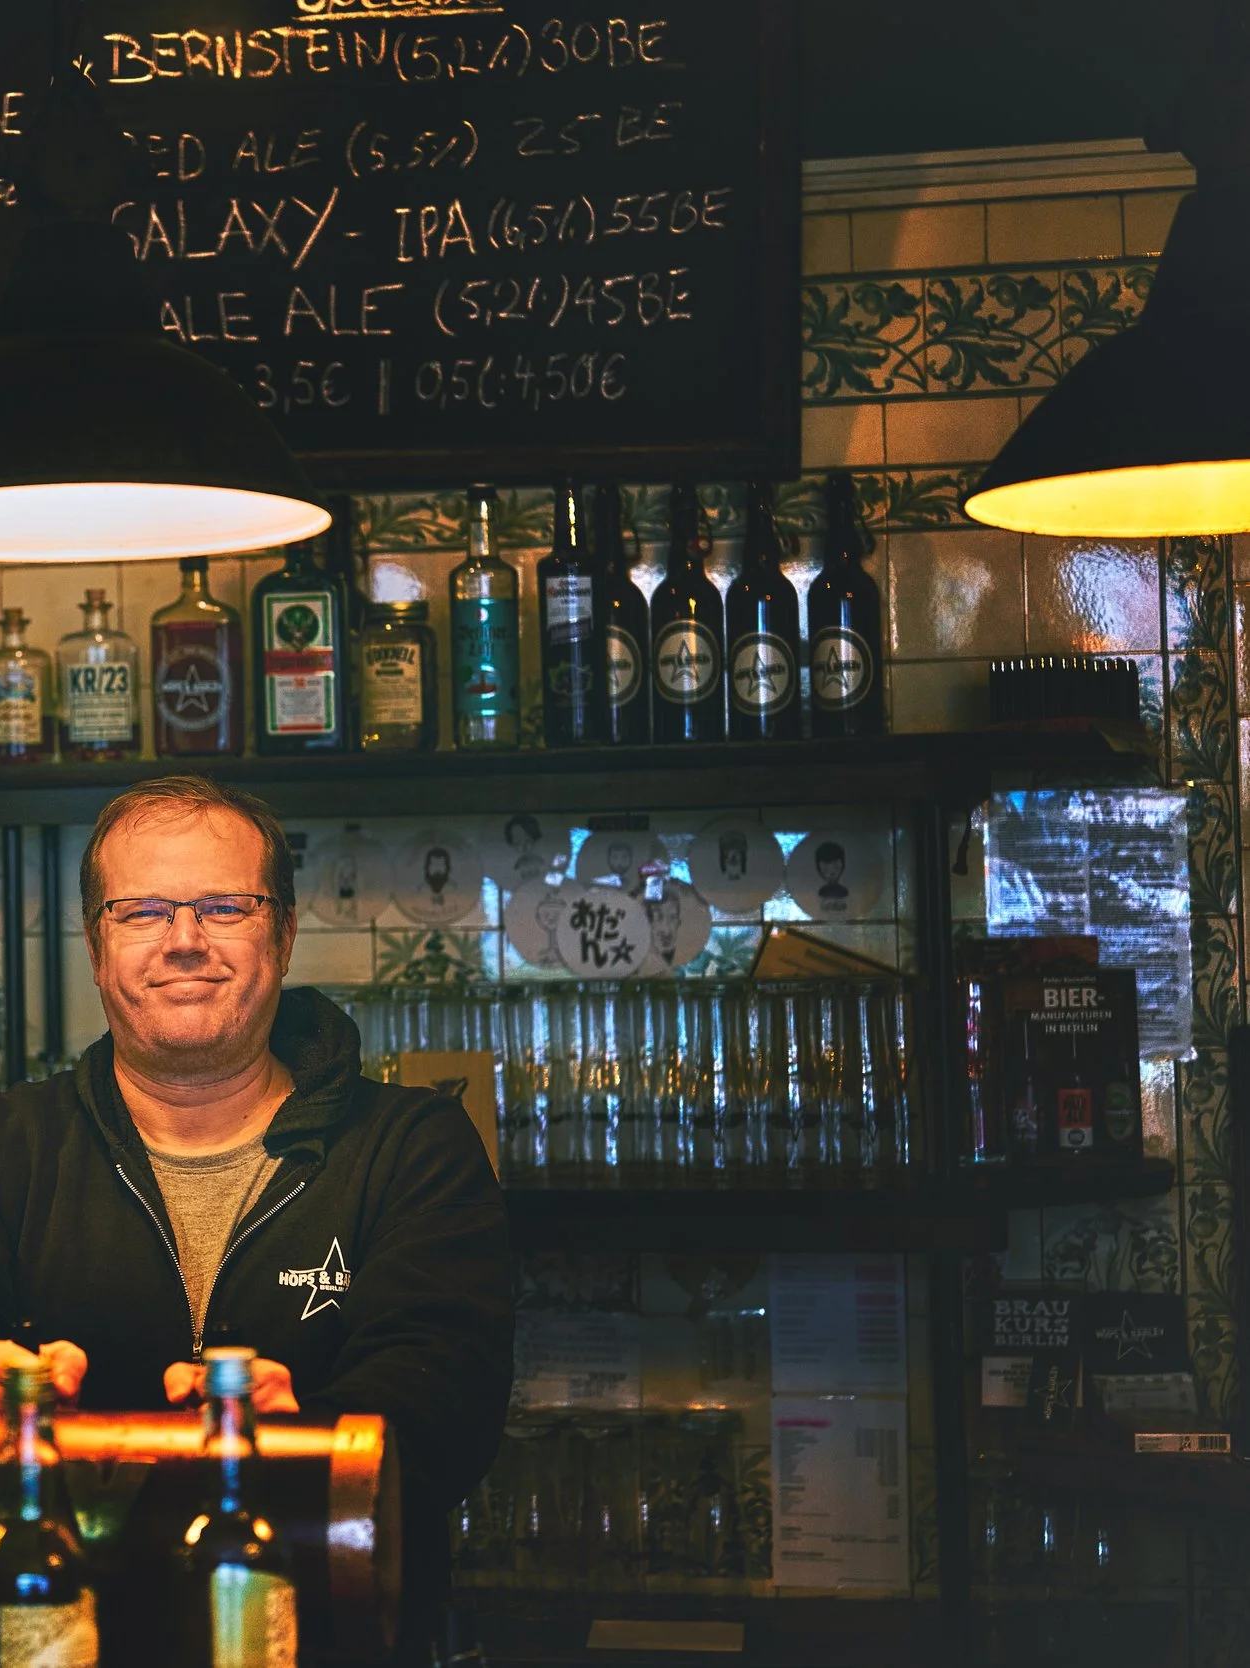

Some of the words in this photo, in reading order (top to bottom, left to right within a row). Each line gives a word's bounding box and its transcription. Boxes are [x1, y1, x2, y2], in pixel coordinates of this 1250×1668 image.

[103, 26, 387, 84] BERNSTEIN
[121, 129, 206, 181] ED
[232, 128, 322, 175] ALE
[395, 199, 478, 263] IPA
[160, 292, 260, 344] ALE
[285, 280, 406, 337] ALE
[69, 666, 129, 695] KR/23
[1043, 987, 1106, 1008] BIER-
[1030, 1010, 1112, 1022] MANUFAKTUREN
[1045, 1023, 1058, 1034] IN
[1059, 1022, 1099, 1033] BERLIN
[278, 1271, 316, 1287] HOPS
[318, 1271, 331, 1285] &
[993, 1299, 1071, 1317] BRAU
[993, 1317, 1070, 1334] KURS
[993, 1334, 1070, 1347] BERLIN
